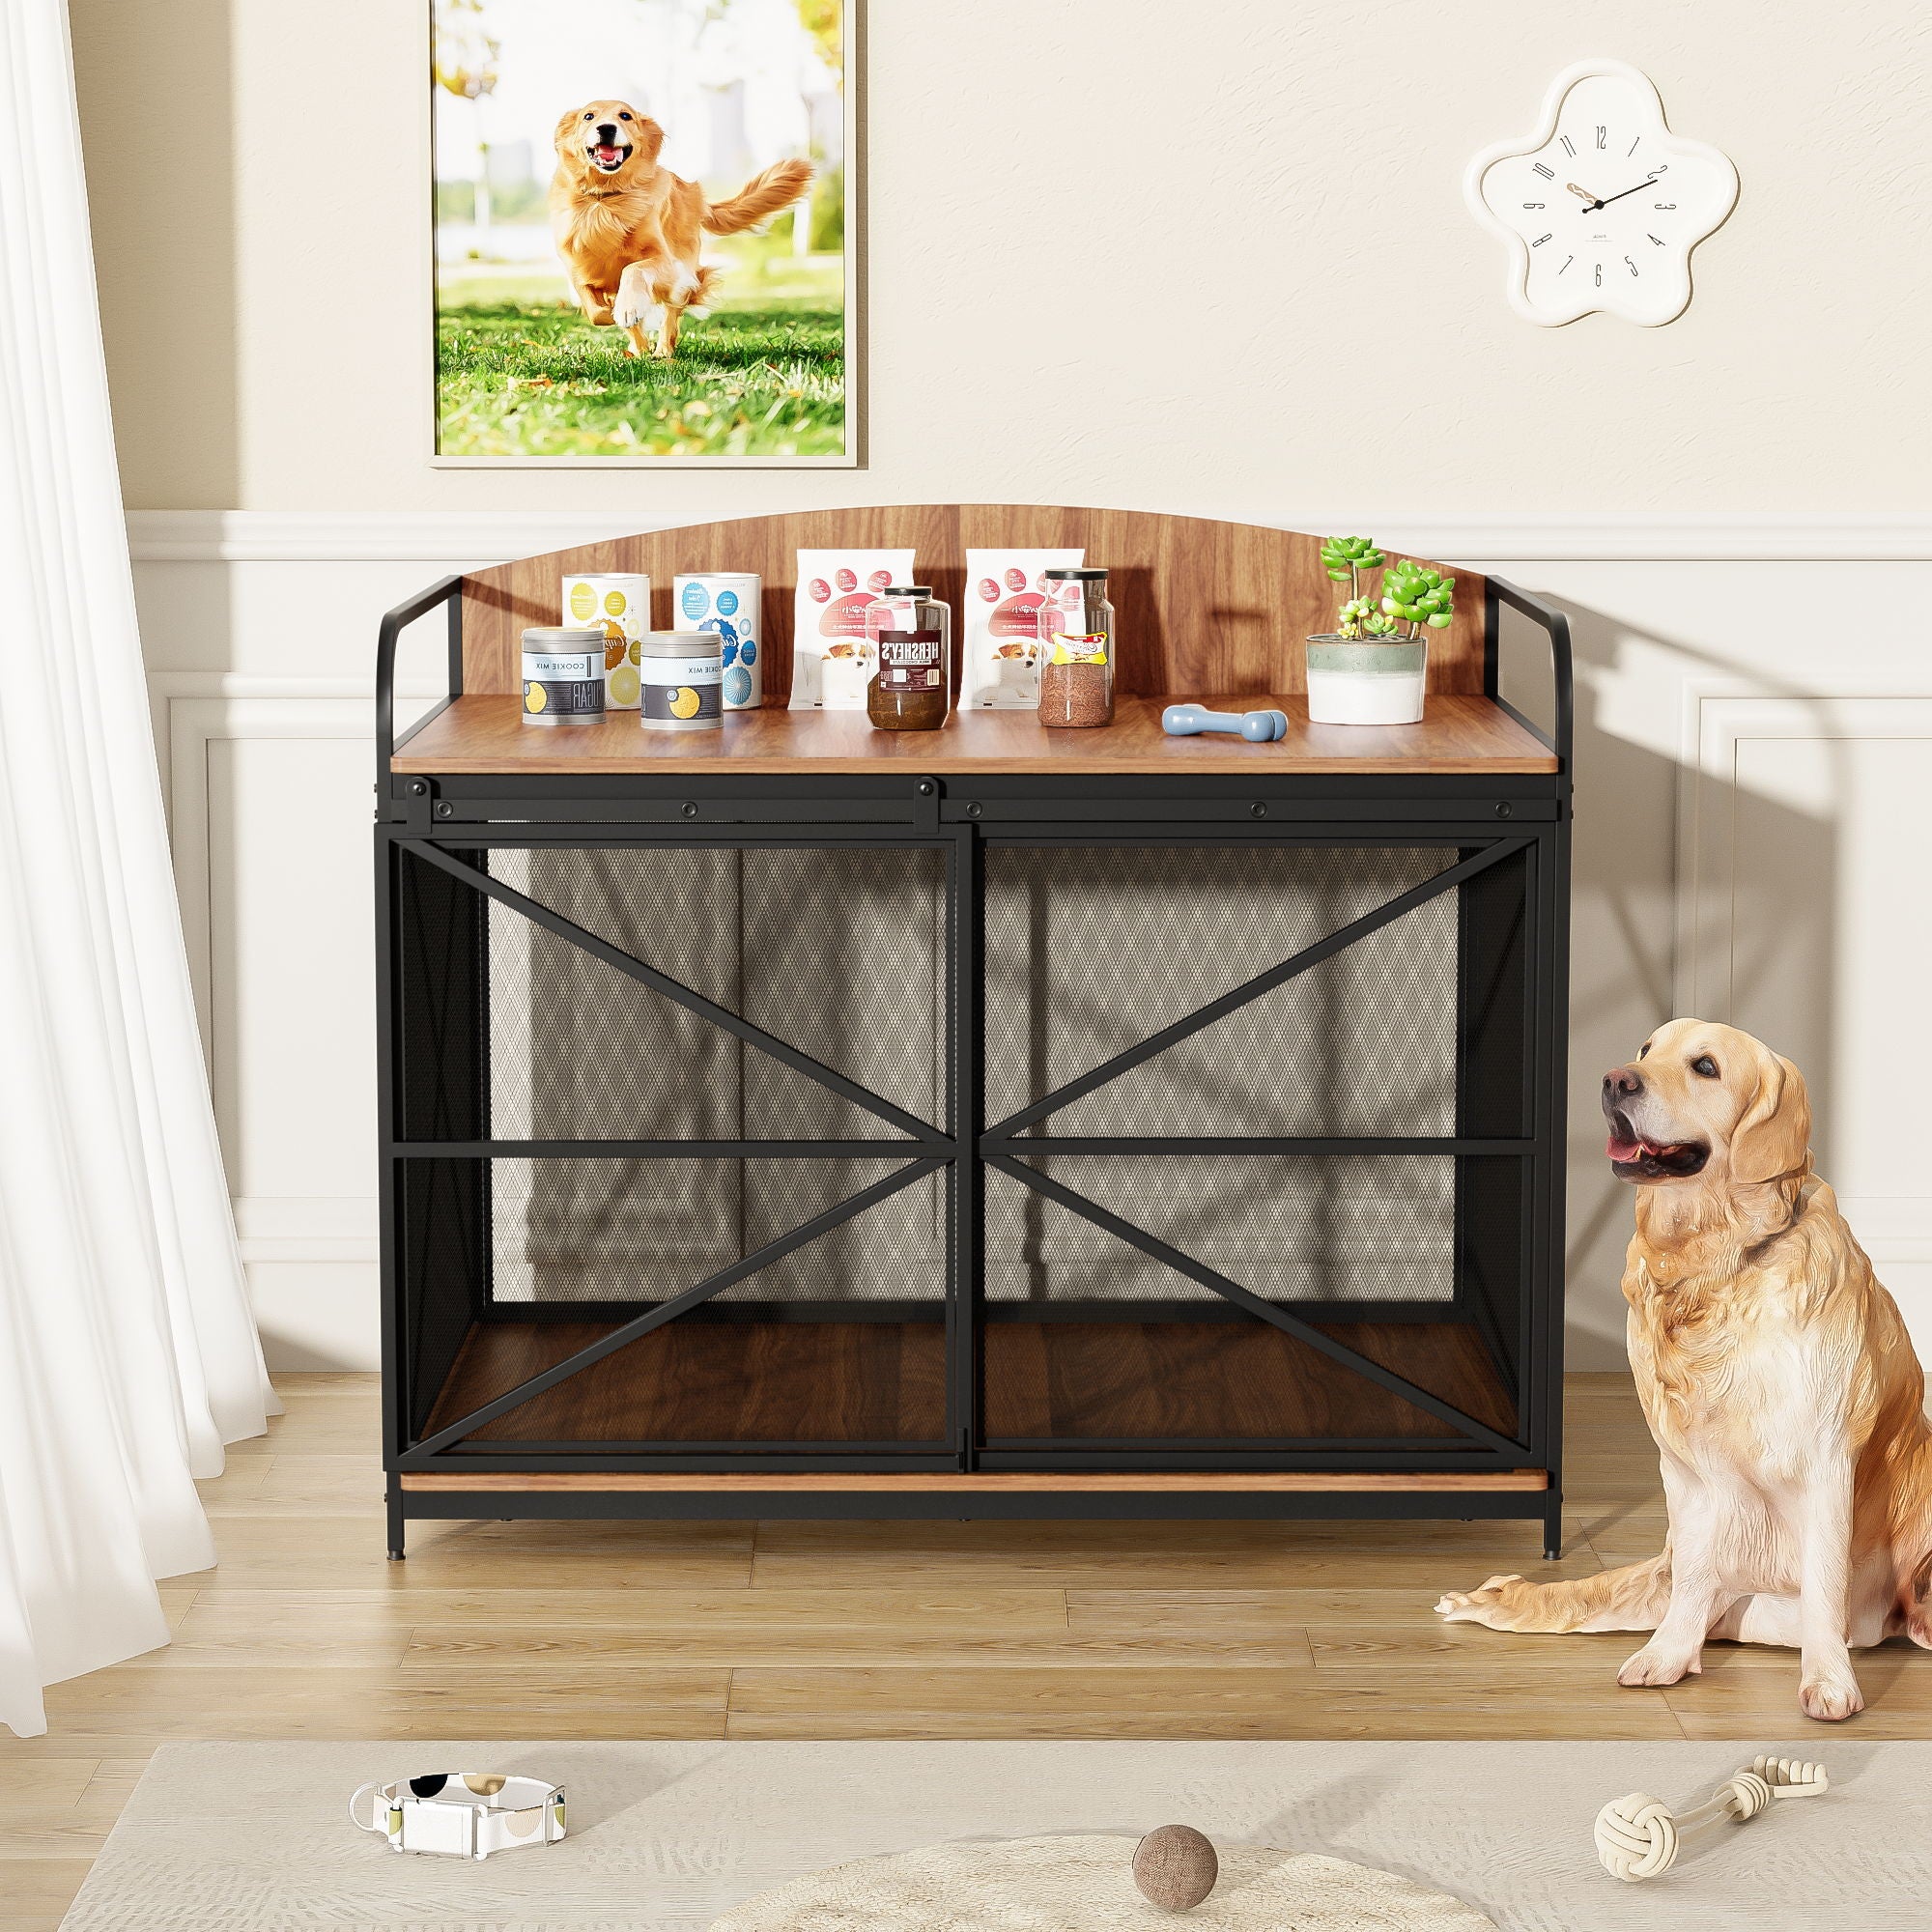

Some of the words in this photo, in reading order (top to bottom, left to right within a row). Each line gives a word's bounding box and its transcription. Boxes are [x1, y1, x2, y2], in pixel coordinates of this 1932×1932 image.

[1559, 135, 1577, 157] 11
[1596, 126, 1606, 150] 12
[1628, 136, 1640, 157] 1
[1532, 162, 1555, 181] 10
[1647, 165, 1668, 180] 2
[1532, 233, 1552, 247] 8
[1647, 234, 1666, 246] 4
[1558, 255, 1574, 275] 7
[1625, 255, 1638, 277] 5
[1595, 264, 1602, 287] 6
